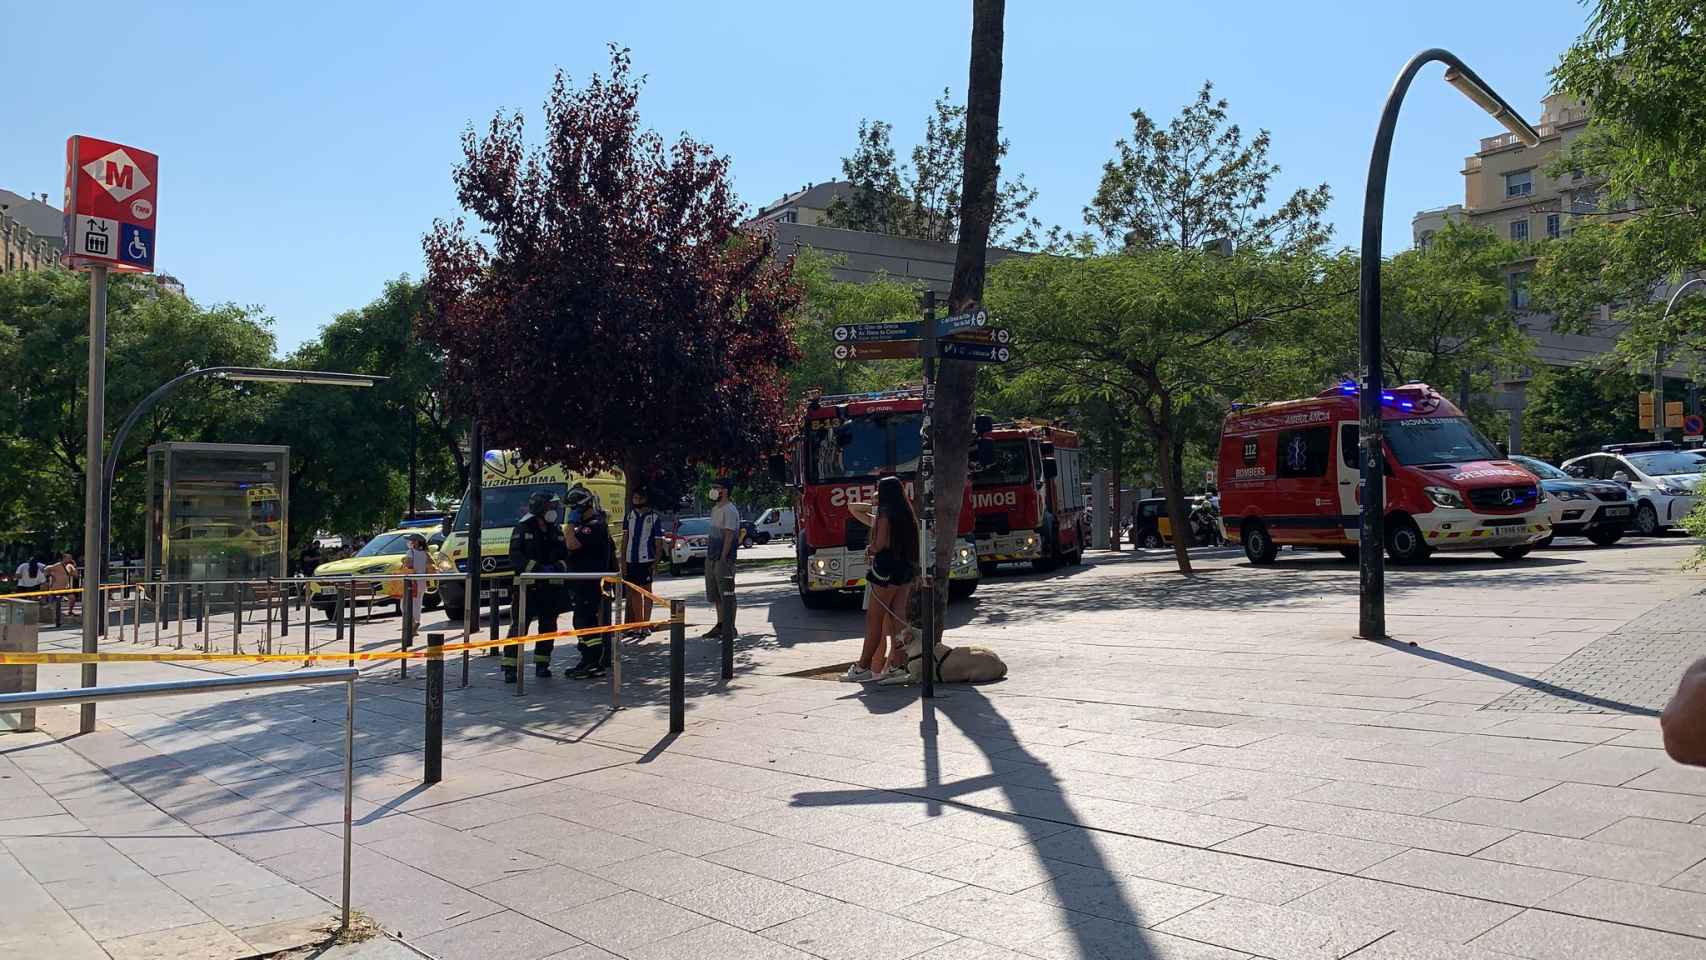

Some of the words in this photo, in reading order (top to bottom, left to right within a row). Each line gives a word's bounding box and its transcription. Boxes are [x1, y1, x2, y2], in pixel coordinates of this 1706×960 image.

[105, 160, 133, 190] M
[1244, 444, 1257, 456] 112
[1235, 467, 1265, 479] BOMBERS
